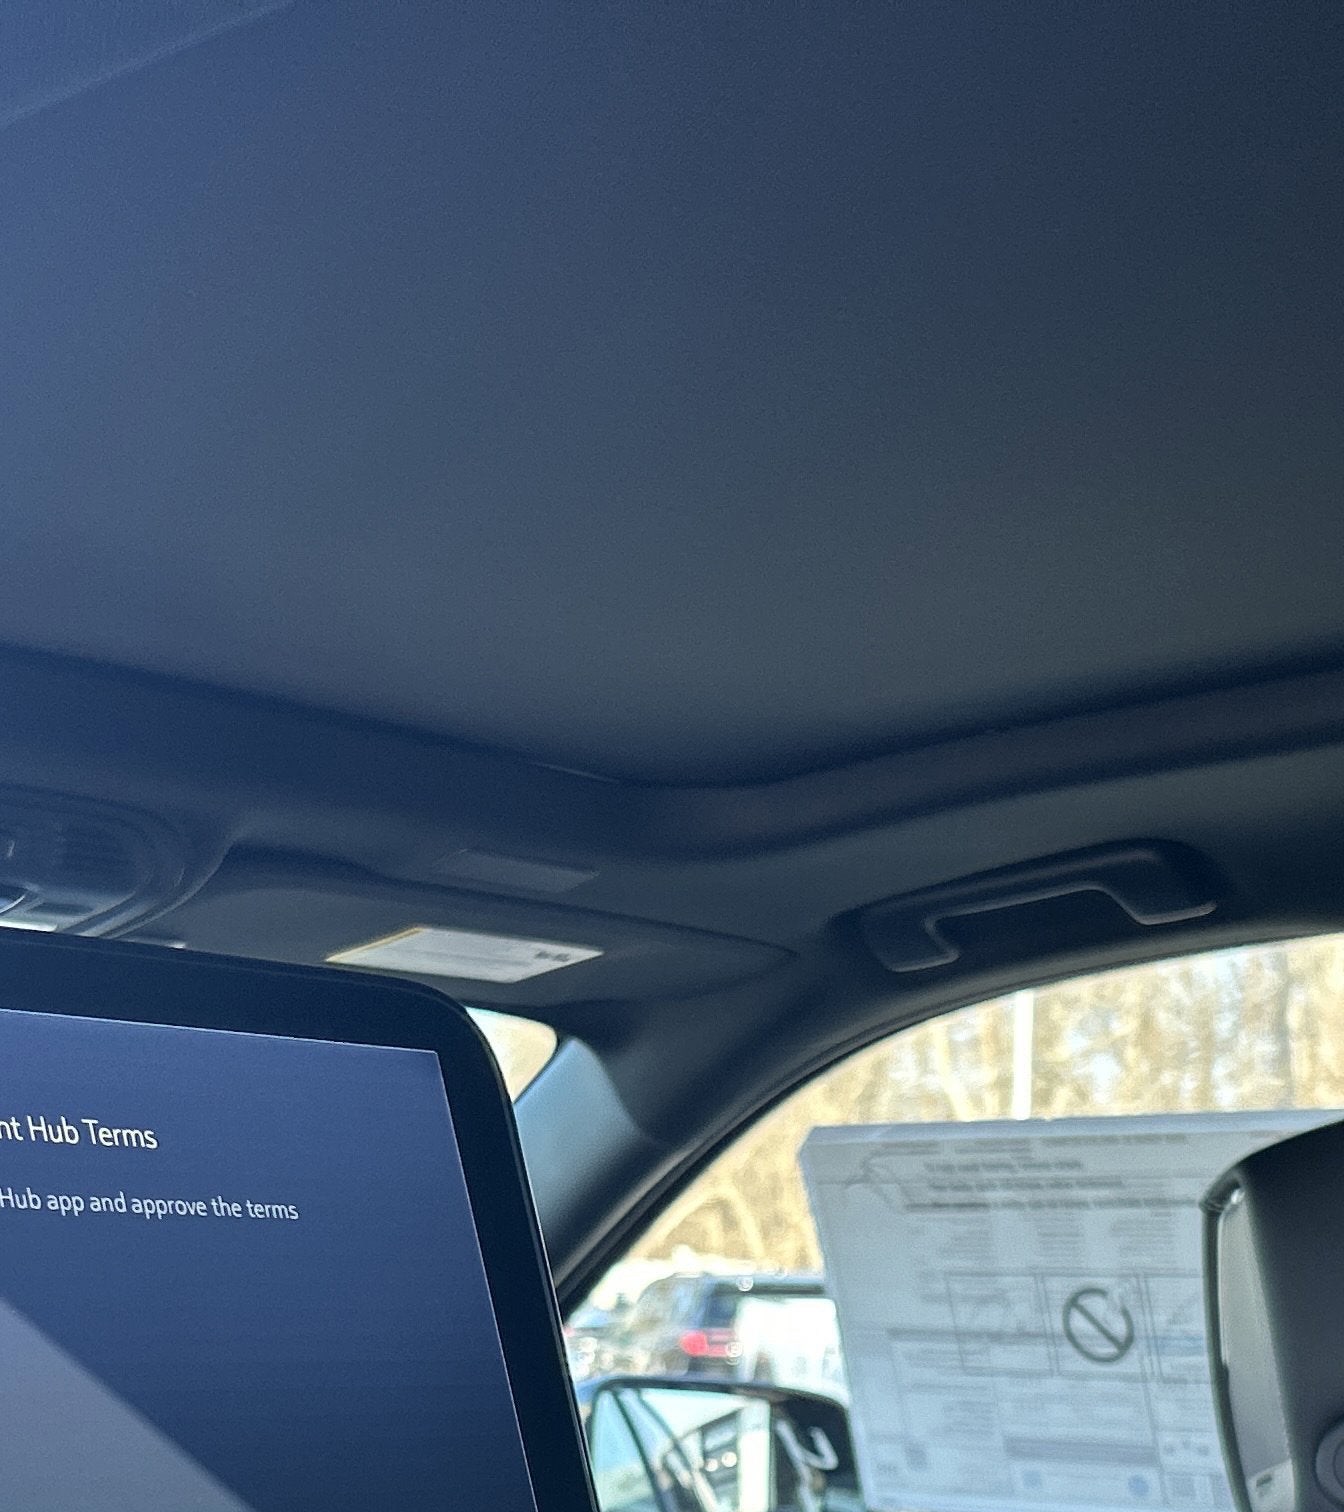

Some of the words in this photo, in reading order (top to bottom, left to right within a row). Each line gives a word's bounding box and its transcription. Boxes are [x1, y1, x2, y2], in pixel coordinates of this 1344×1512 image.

[26, 1115, 80, 1144] Hub
[81, 1119, 158, 1149] Terms
[46, 1194, 85, 1216] app
[89, 1191, 127, 1213] and
[131, 1197, 208, 1219] approve
[211, 1195, 243, 1218] the
[246, 1199, 299, 1220] terms
